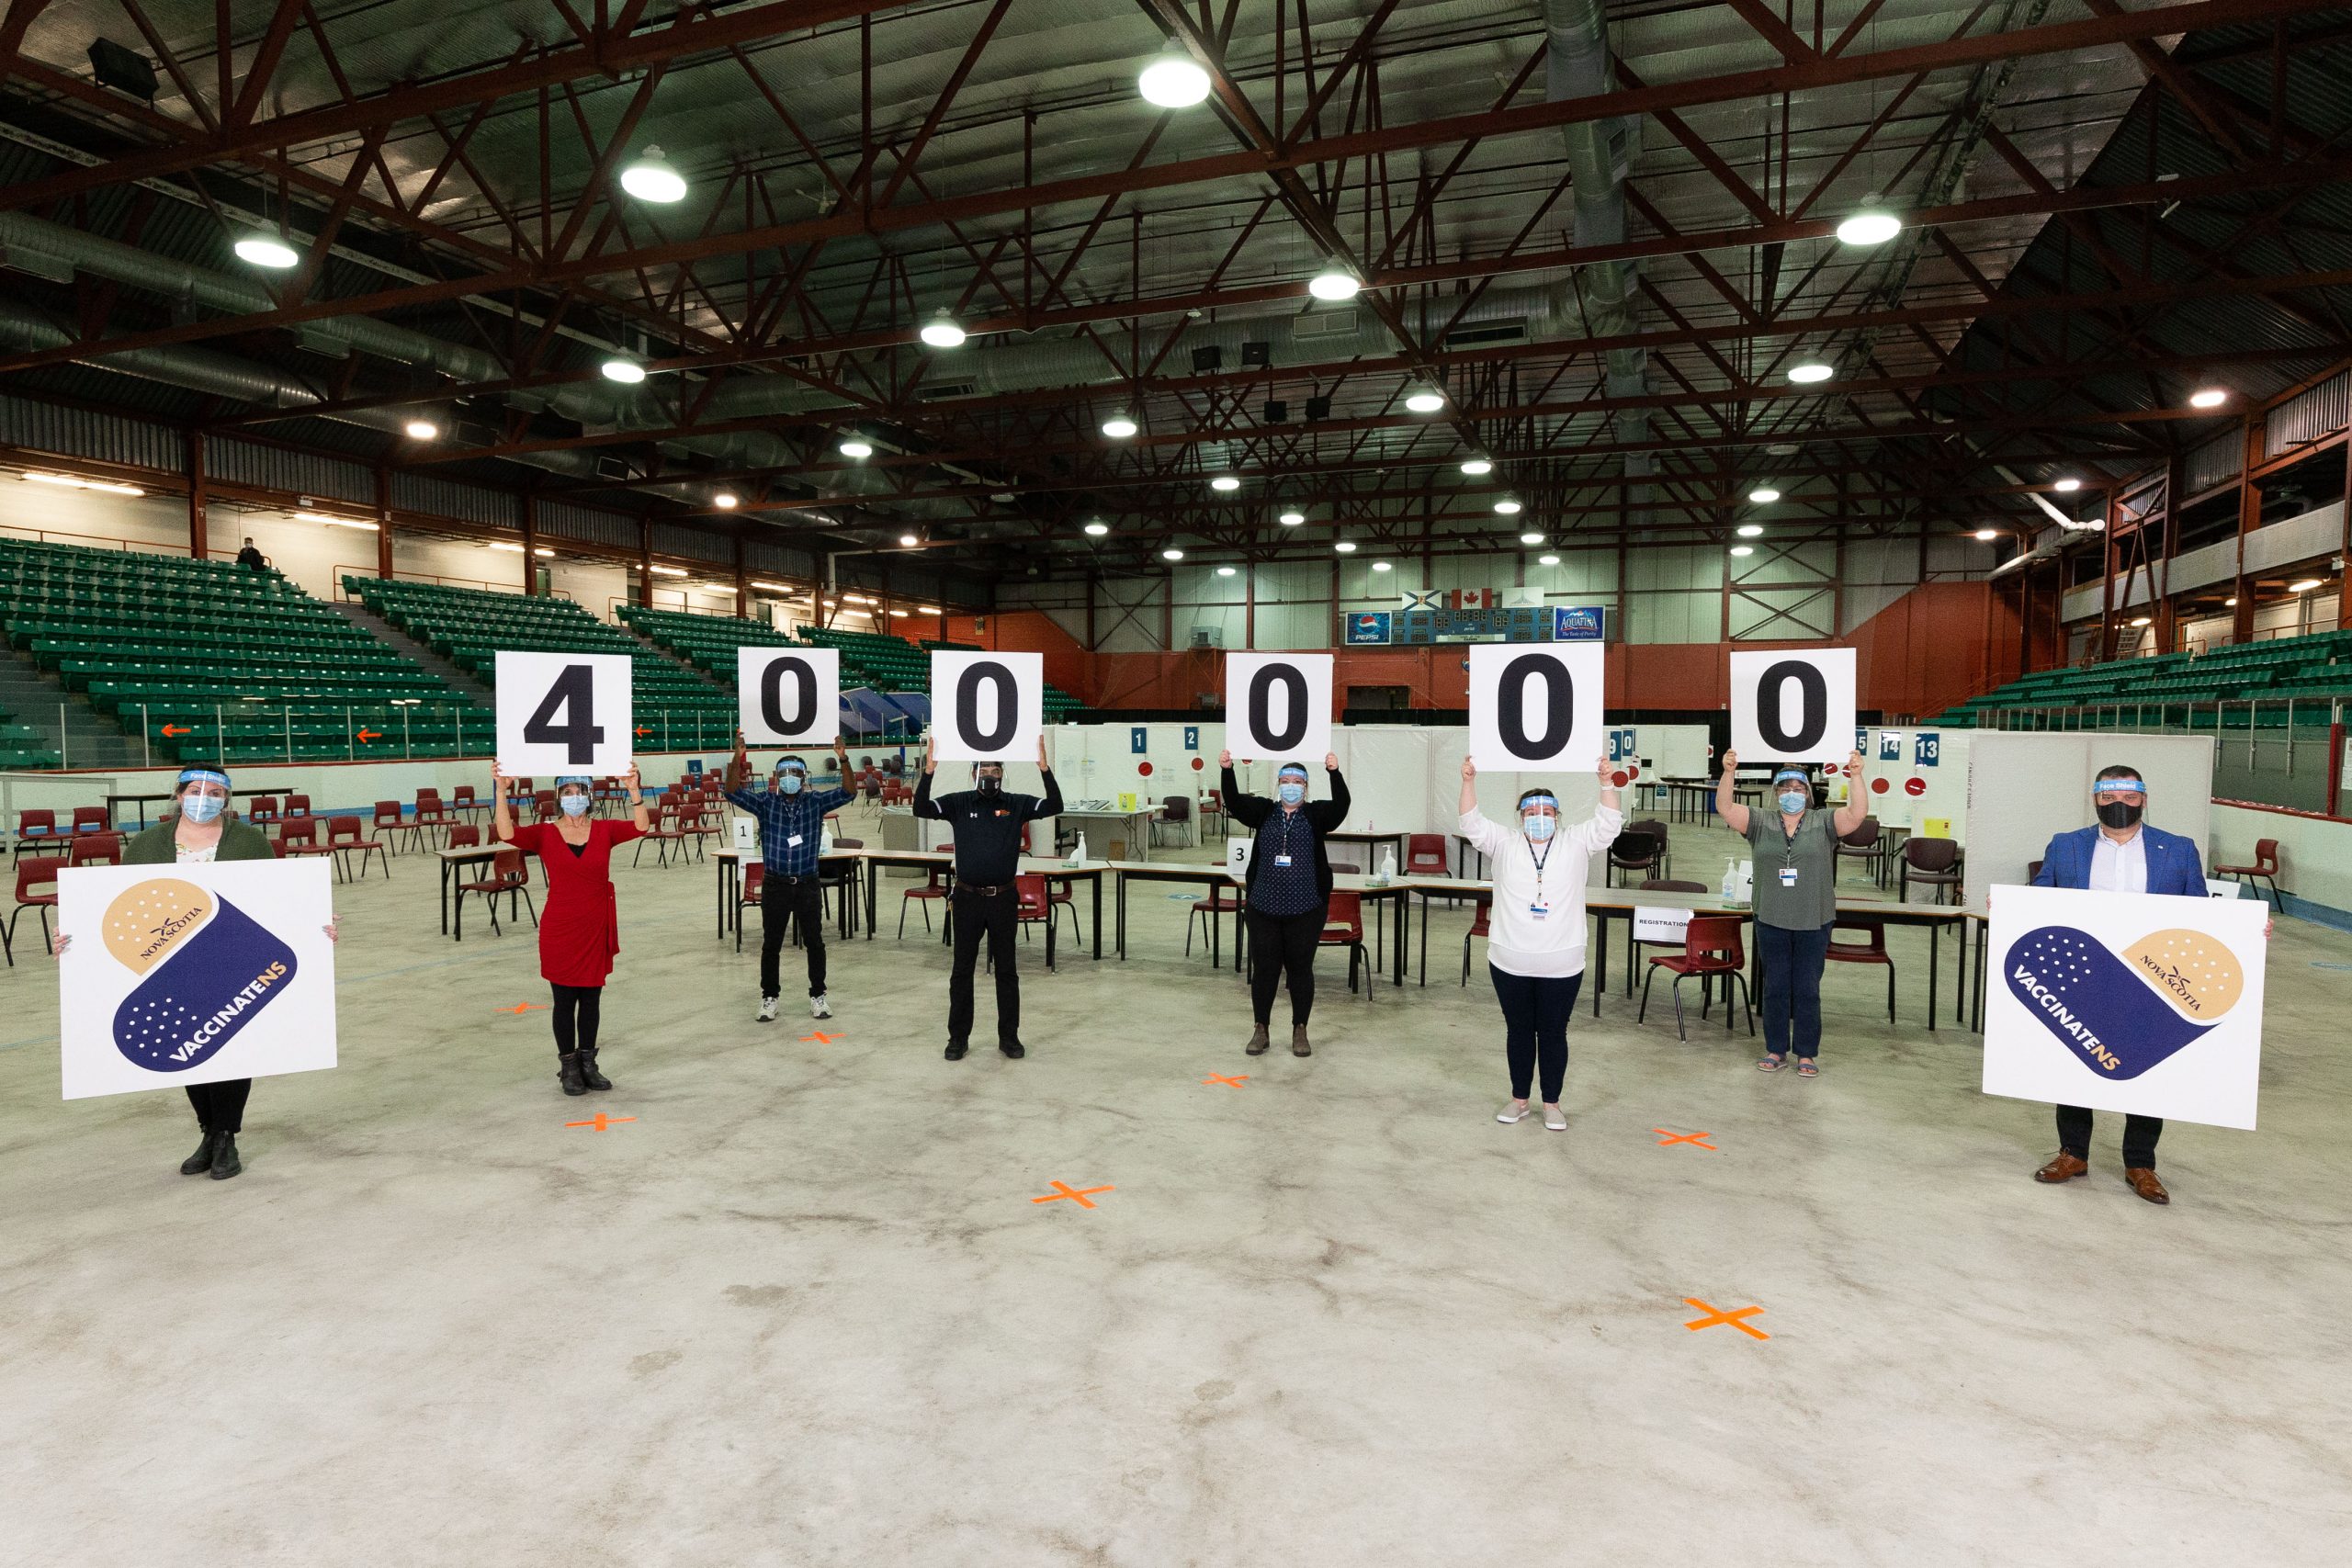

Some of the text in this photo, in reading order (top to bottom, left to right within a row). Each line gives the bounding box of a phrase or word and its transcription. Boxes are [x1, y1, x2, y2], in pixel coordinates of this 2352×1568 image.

[524, 665, 604, 764] 4
[762, 657, 817, 736] 0
[956, 661, 1018, 751] 0
[1250, 663, 1307, 751] 0
[1498, 654, 1573, 760] 0
[1758, 660, 1826, 752] 0
[1135, 733, 1142, 747] 1
[1188, 732, 1194, 744] 2
[1857, 737, 1867, 750] 5
[1883, 739, 1899, 753] 14
[1917, 740, 1938, 758] 13
[740, 825, 747, 837] 1
[1235, 848, 1244, 862] 3
[140, 907, 203, 961] NOVA SCOTIA
[1639, 919, 1688, 927] REGISTRATION
[2139, 954, 2202, 1011] NOVA SCOTIA
[169, 961, 287, 1062] VACCINATENS
[2013, 964, 2120, 1071] VACCINATENS
